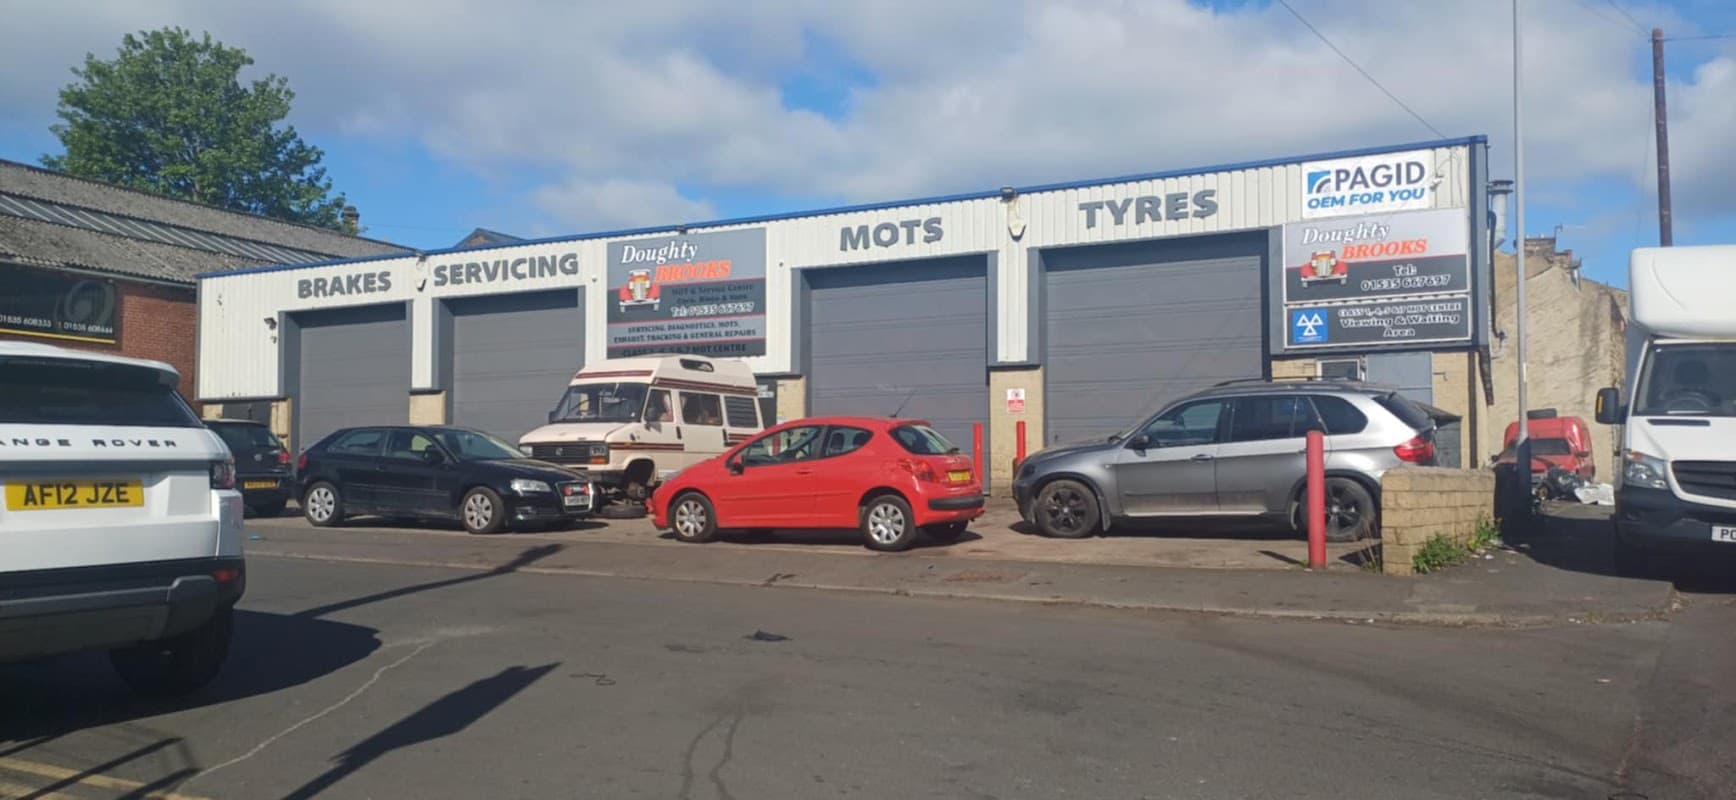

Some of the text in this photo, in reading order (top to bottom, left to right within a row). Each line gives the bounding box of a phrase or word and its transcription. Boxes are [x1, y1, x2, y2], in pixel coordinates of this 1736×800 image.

[1336, 162, 1426, 191] PAGID
[1079, 189, 1218, 229] TYRES
[1308, 188, 1425, 209] OEM FOR YOU
[840, 217, 944, 251] MOTS
[1303, 222, 1390, 245] Doughty
[621, 240, 698, 265] Doughty
[1341, 239, 1427, 259] BROOKS
[433, 253, 579, 286] SERVICING
[654, 259, 731, 282] BROOKS
[298, 271, 391, 299] BRAKES
[1360, 274, 1451, 291] 01535 667697
[1340, 317, 1393, 328] Viewing
[1406, 314, 1460, 325] Waiting
[1383, 327, 1415, 337] Area
[92, 439, 177, 447] ROVER
[24, 482, 130, 506] AF12 JZE
